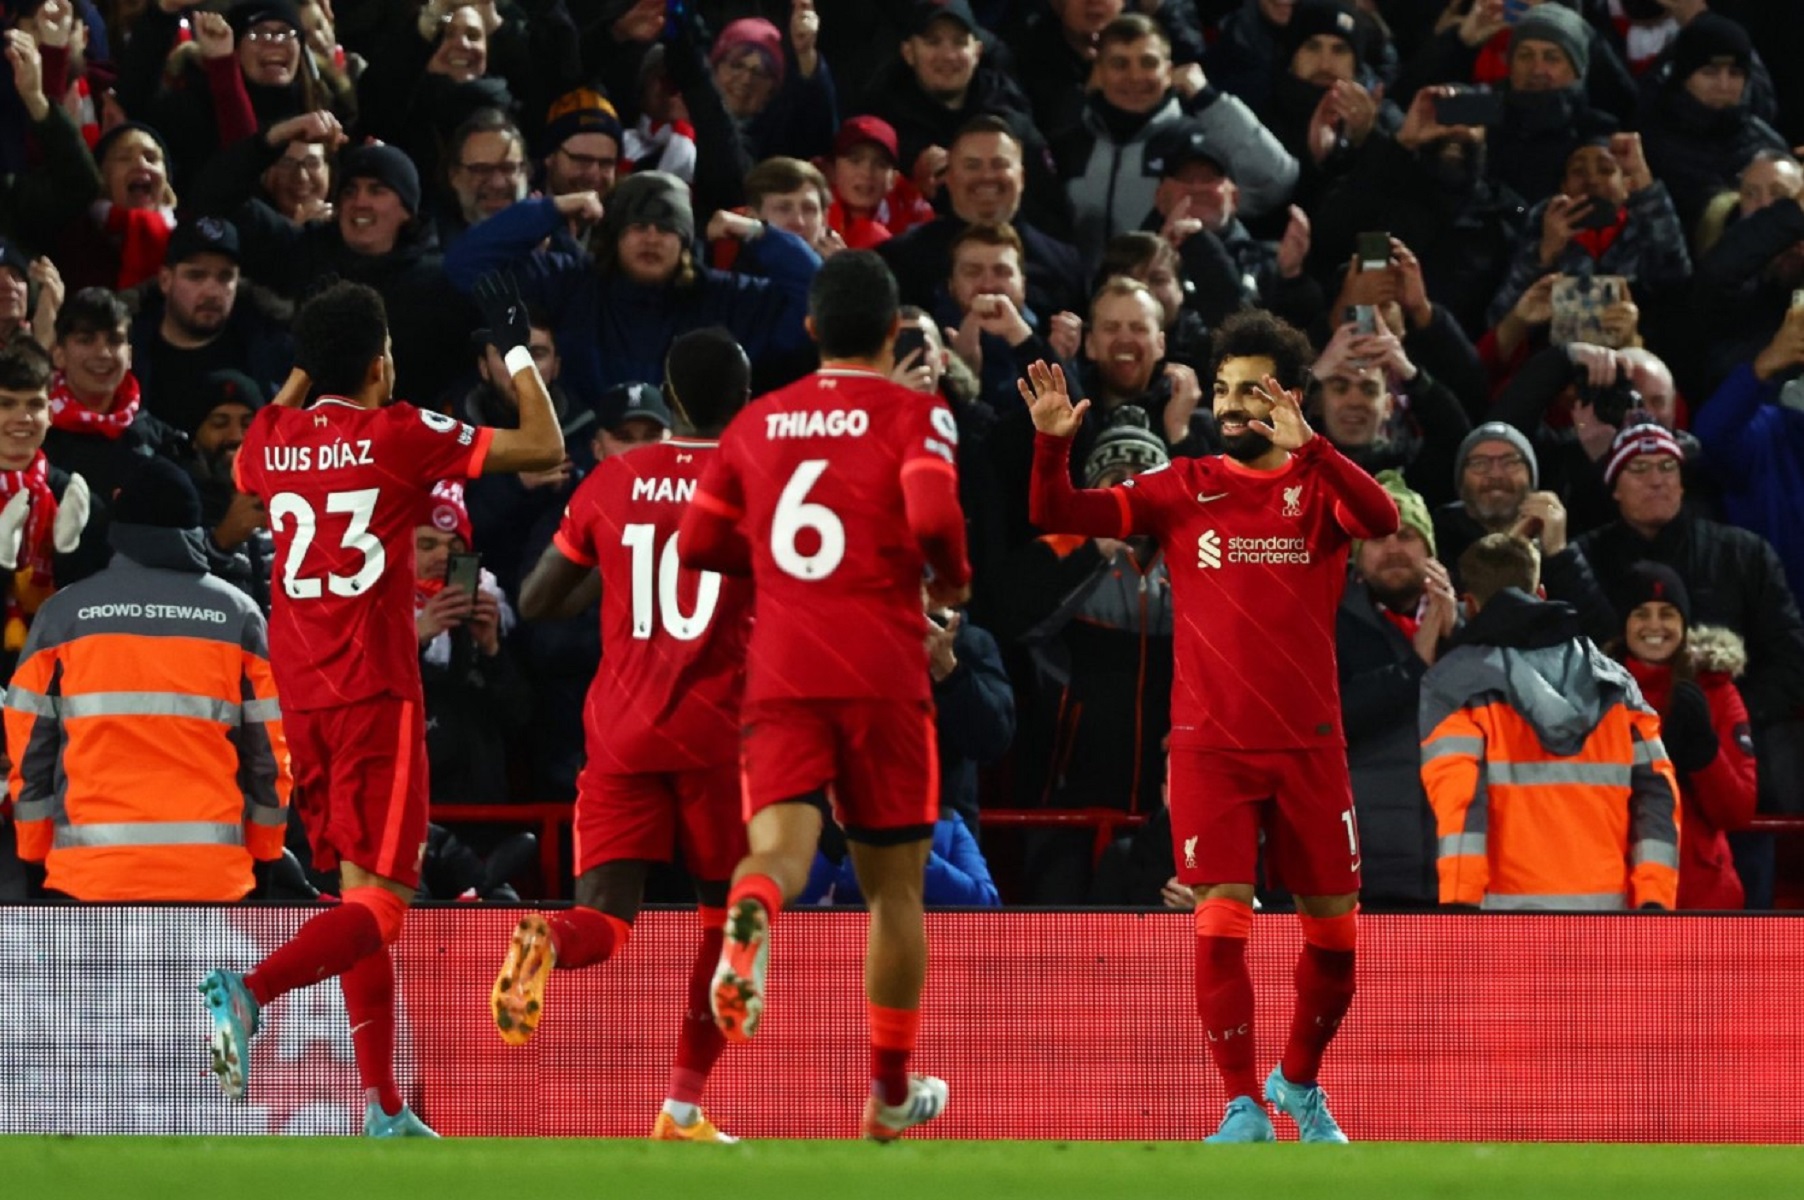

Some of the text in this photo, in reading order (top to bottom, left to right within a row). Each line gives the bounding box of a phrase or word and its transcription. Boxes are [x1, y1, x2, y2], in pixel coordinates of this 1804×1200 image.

[765, 409, 869, 440] THIAGO
[264, 436, 374, 471] LUIS DÍAZ
[632, 477, 697, 502] MAN
[770, 459, 845, 581] 6
[269, 488, 385, 599] 23
[1227, 536, 1305, 550] standard
[1227, 550, 1310, 564] chartered
[621, 523, 722, 641] 10
[77, 603, 227, 623] CROWD STEWARD
[1341, 805, 1357, 856] 1
